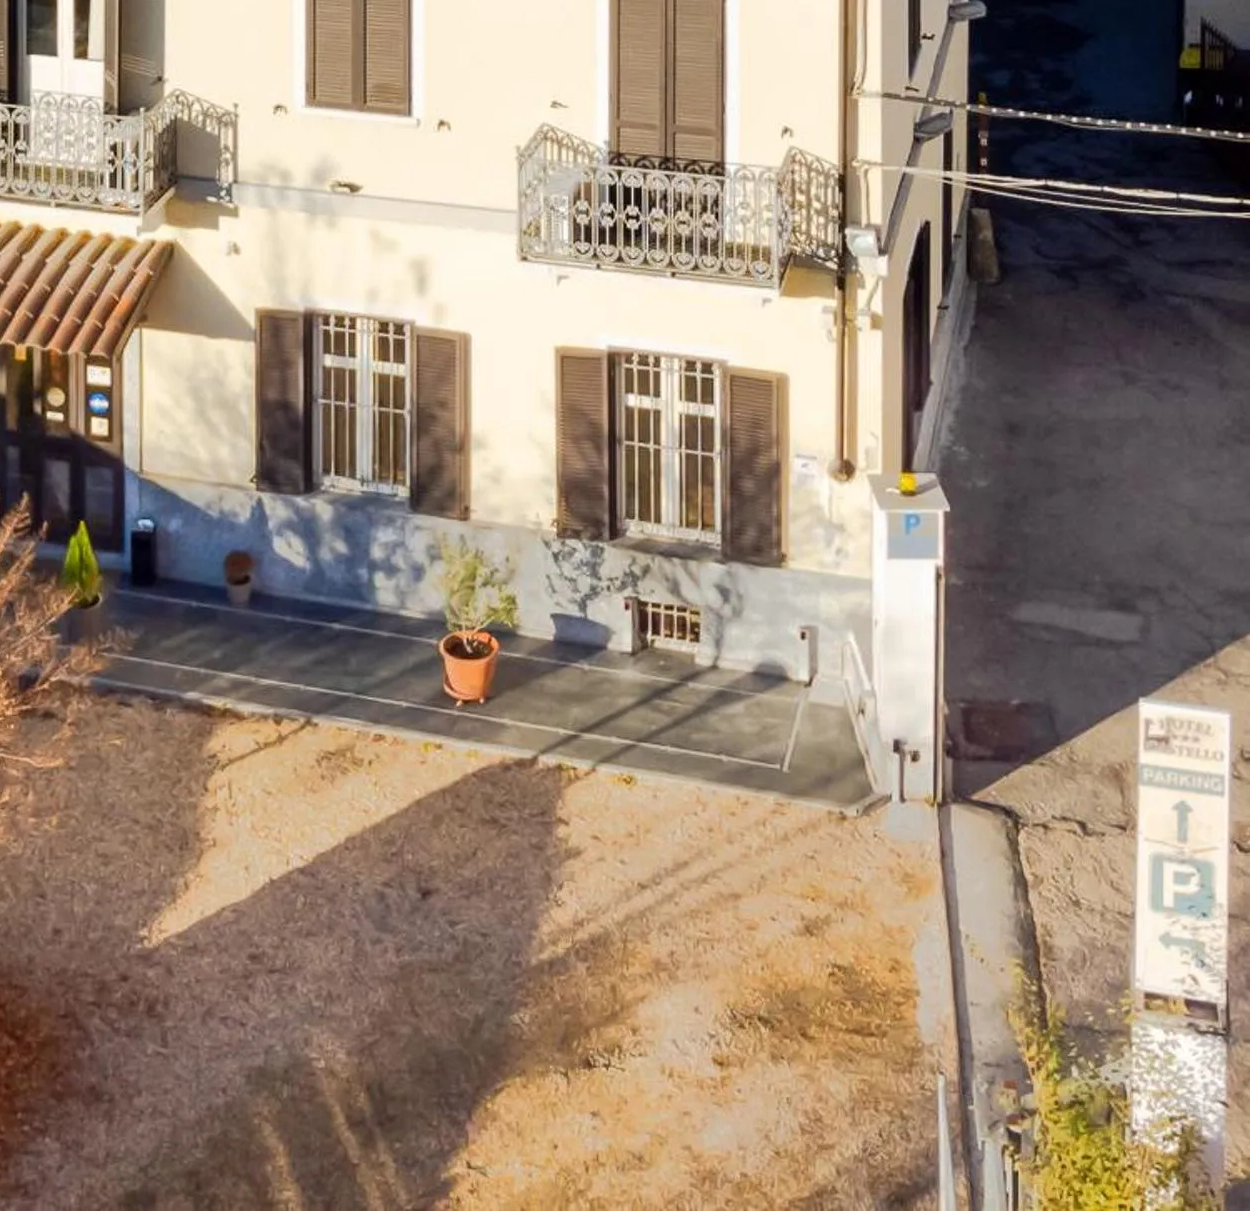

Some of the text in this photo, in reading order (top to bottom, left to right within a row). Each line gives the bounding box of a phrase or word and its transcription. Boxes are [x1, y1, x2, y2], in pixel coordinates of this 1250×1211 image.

[903, 514, 920, 534] P
[1142, 767, 1223, 793] PARKING
[1163, 861, 1200, 908] P
